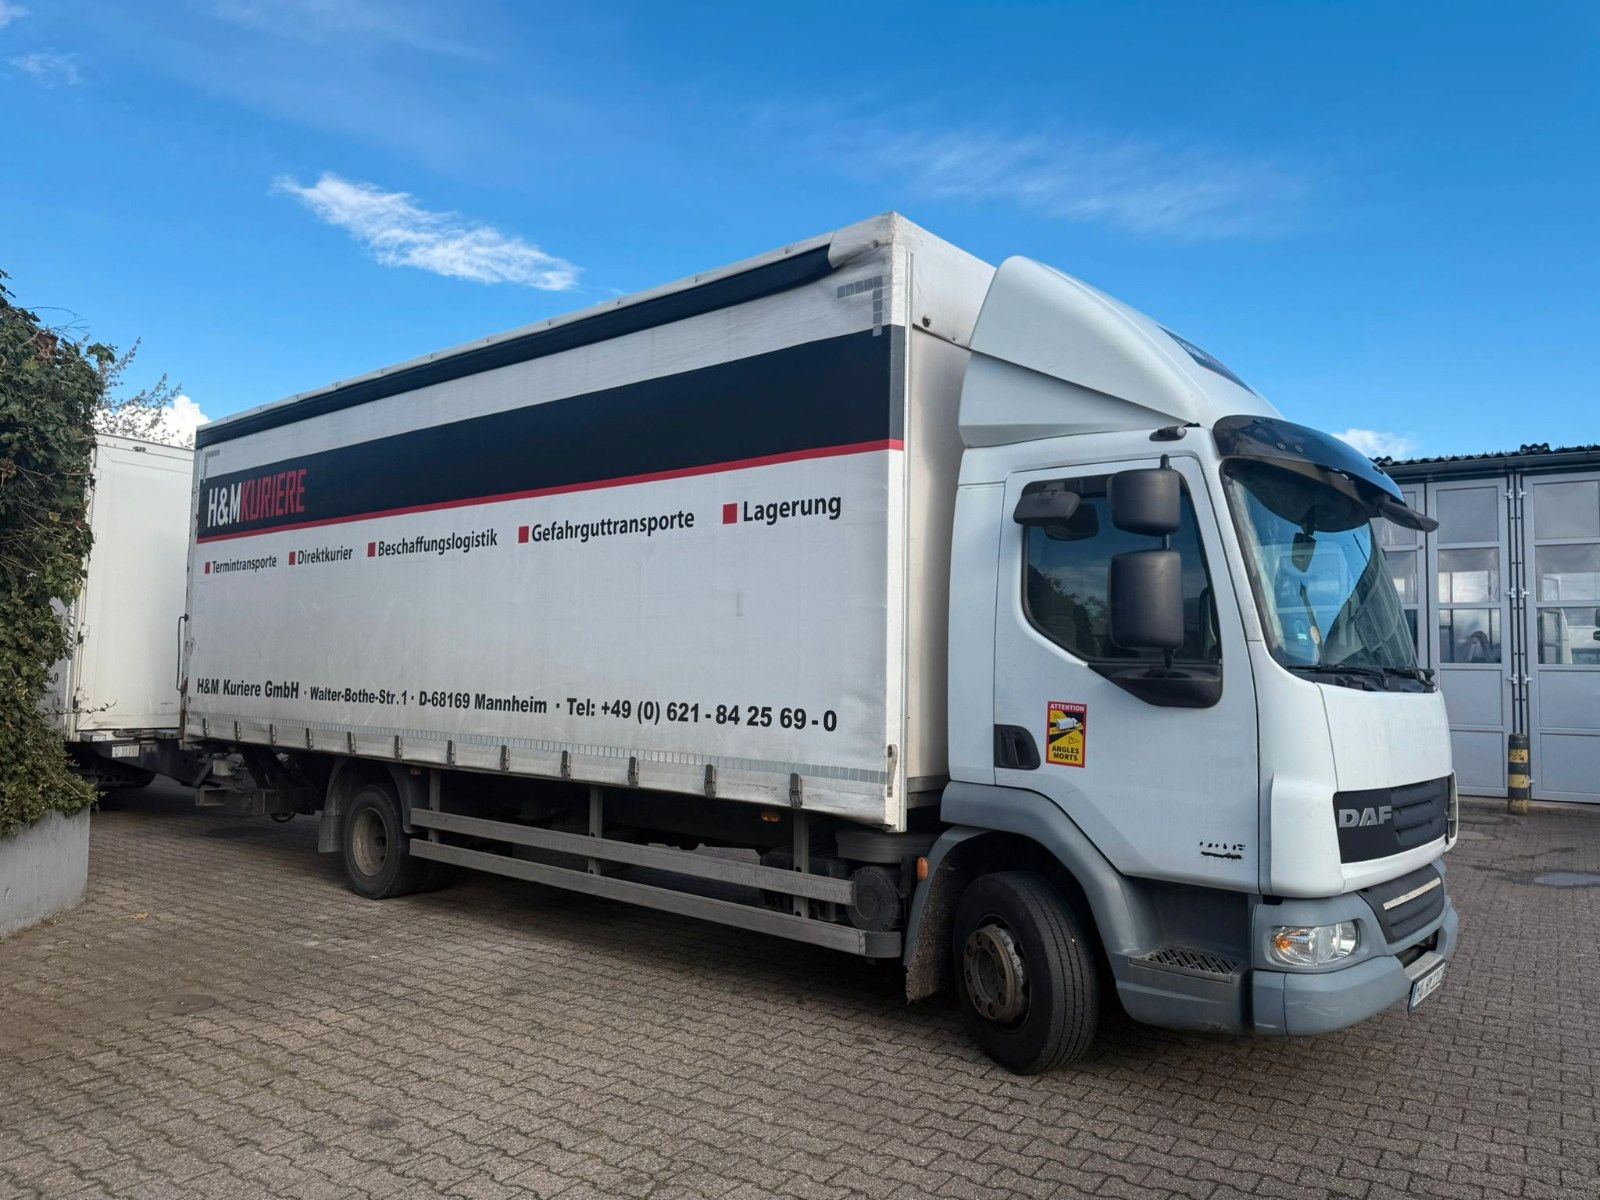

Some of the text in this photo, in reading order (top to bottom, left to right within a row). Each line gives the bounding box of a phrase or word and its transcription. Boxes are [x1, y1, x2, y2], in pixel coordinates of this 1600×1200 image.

[212, 496, 842, 574] Termintransporte Direktkurier Beschaffungslogistik Gefahrguttransporte Lagerung
[197, 678, 219, 695] H&M
[223, 680, 261, 697] Kuriere
[264, 680, 299, 699] GmbH
[419, 690, 470, 709] D-68169
[474, 693, 547, 714] Mannheim
[566, 697, 596, 717] Tel:
[601, 699, 632, 719] +49
[637, 701, 661, 725] (0)
[746, 705, 773, 728] 25
[1050, 703, 1085, 712] ATTENTION
[1051, 744, 1080, 755] ANGLES
[1053, 752, 1078, 761] MORTS
[1338, 805, 1393, 828] DAF
